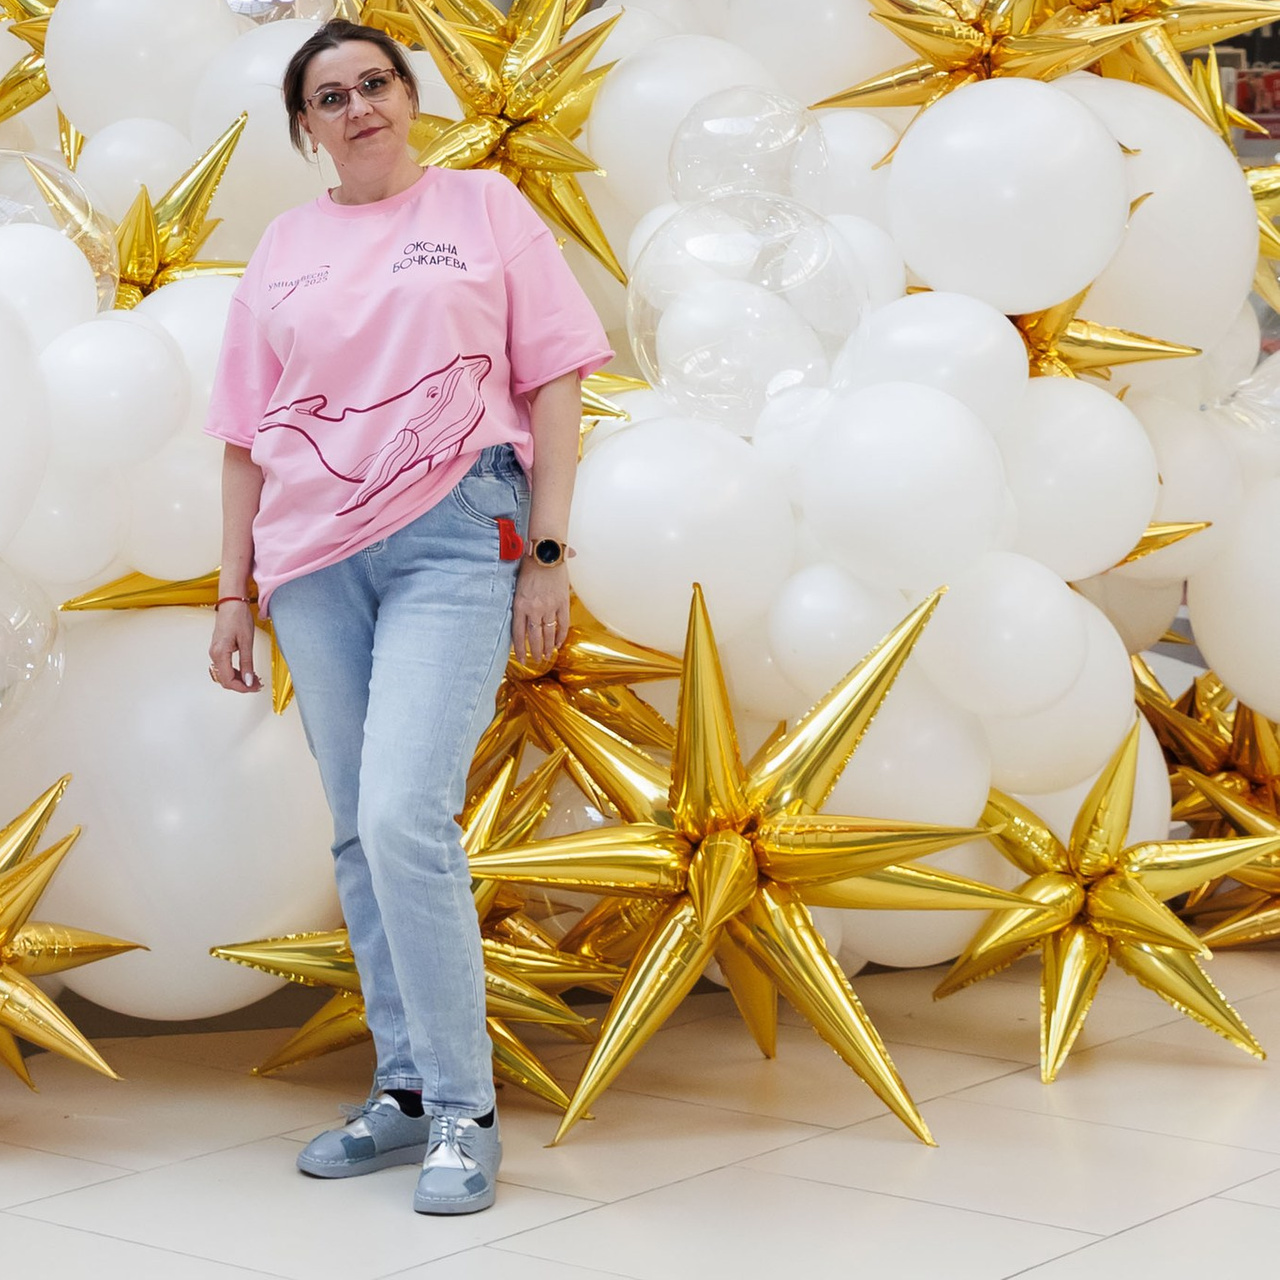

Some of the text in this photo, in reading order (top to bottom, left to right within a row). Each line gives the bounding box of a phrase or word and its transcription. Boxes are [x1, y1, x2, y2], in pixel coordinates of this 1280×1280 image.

[403, 240, 458, 256] ОКСАНА
[392, 255, 468, 273] БОЧКАРЕВА
[268, 270, 329, 291] УМНАЯ ВЕСНА
[304, 277, 328, 287] 2025
